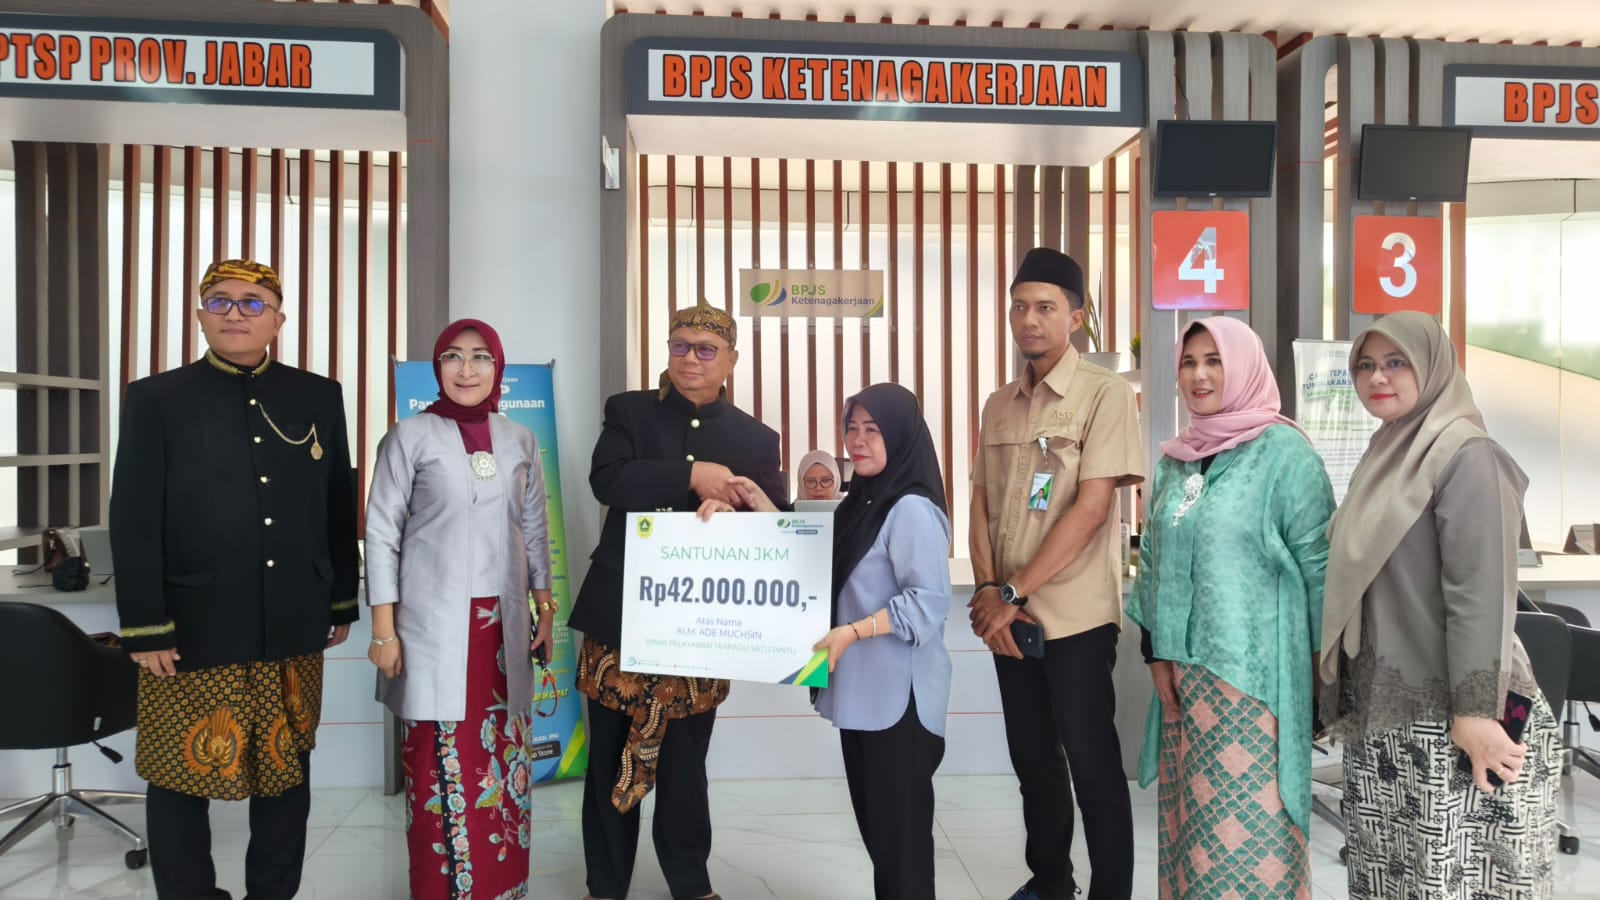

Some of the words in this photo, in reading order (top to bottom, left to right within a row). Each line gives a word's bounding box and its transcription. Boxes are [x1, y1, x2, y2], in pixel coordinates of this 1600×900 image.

[89, 36, 195, 84] PROV.
[203, 41, 312, 88] JABAR
[663, 54, 752, 99] BPJS
[762, 57, 1107, 107] KETENAGAKERJAAN
[1504, 82, 1599, 125] BPJS
[1178, 227, 1224, 293] 4
[1379, 232, 1417, 298] 3
[791, 285, 826, 295] BPJS
[791, 296, 875, 307] Ketenagakerjaan
[498, 398, 545, 410] gunaan
[660, 546, 749, 561] SANTUNAN
[754, 547, 789, 561] JKM
[639, 575, 818, 612] Rp42.000.000,-
[696, 616, 714, 625] Atas
[717, 617, 742, 627] Nama
[699, 628, 717, 637] ADE
[719, 630, 762, 640] MUCHSIN
[714, 642, 750, 652] TERPADU
[751, 644, 770, 653] SATU
[772, 645, 796, 656] PINTU
